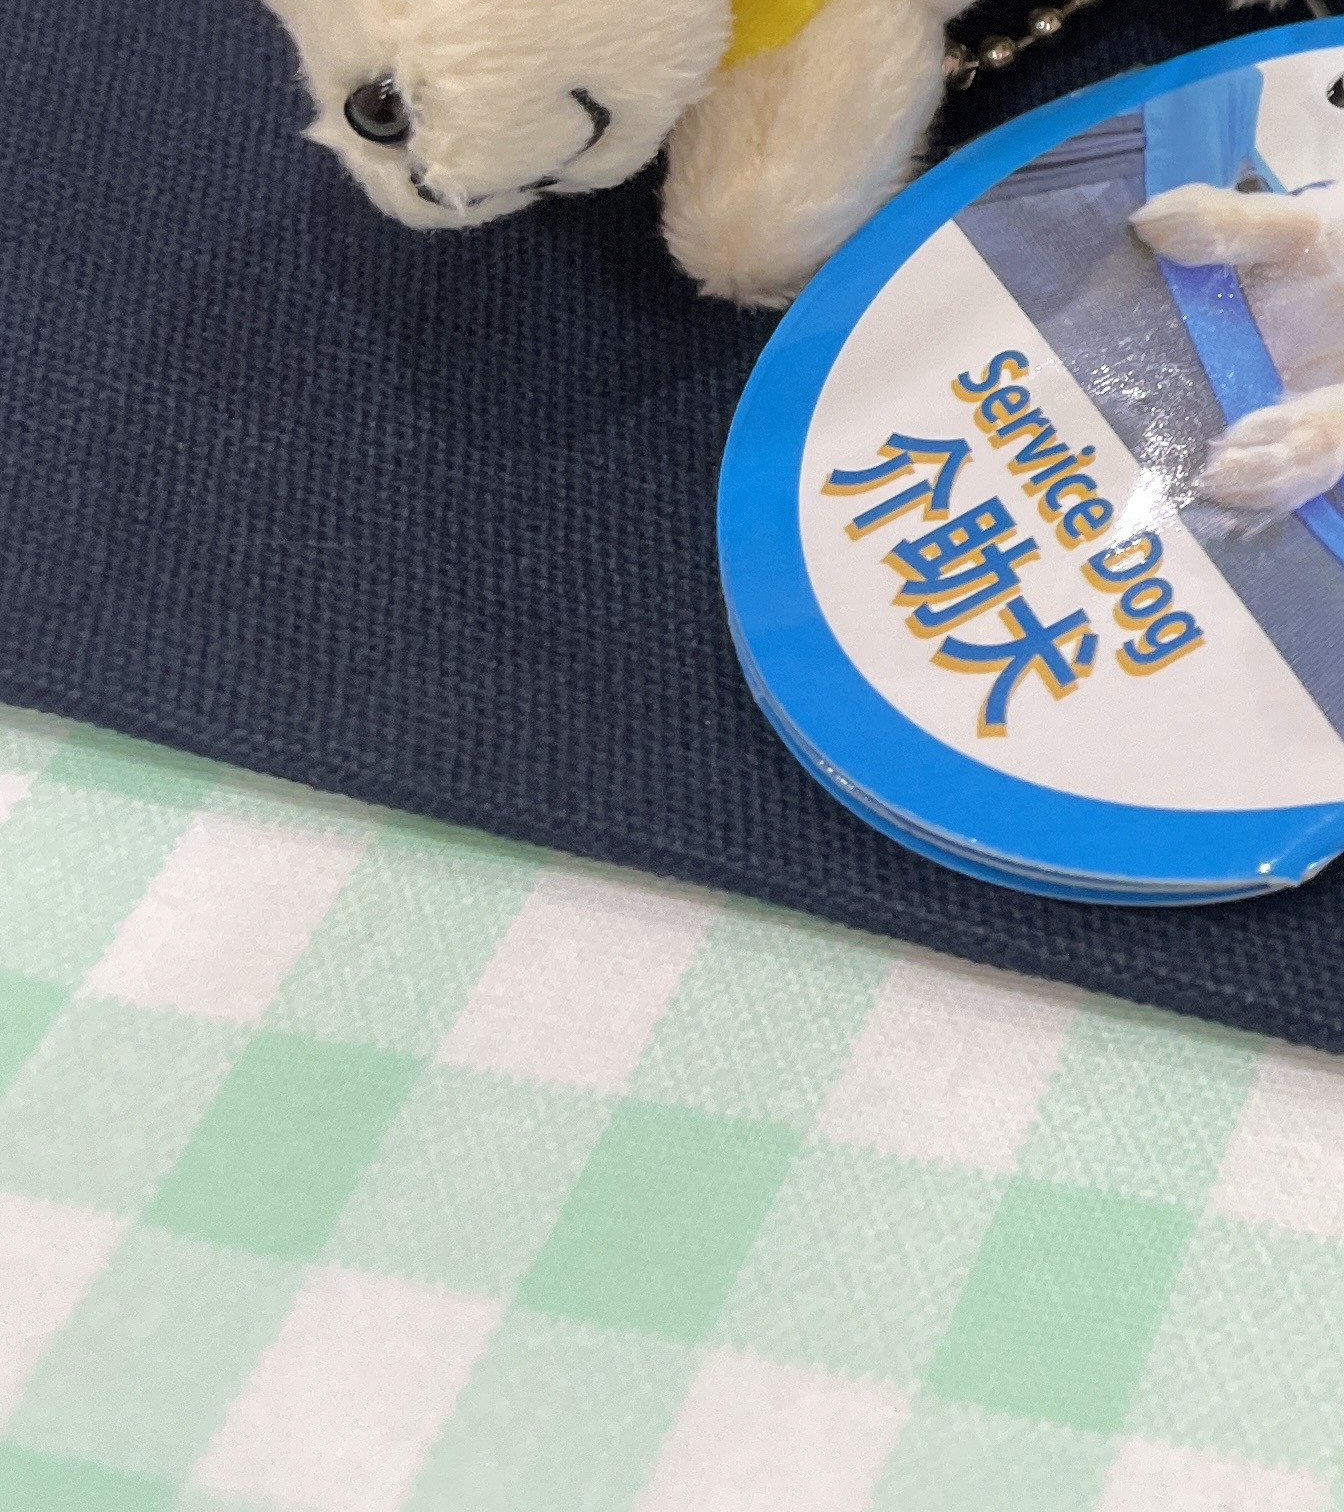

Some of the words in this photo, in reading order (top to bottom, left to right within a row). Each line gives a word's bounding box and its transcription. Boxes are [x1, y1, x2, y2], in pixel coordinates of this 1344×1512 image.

[819, 431, 1100, 739] 介助犬
[950, 348, 1114, 550] Service
[1080, 529, 1207, 677] Dog
